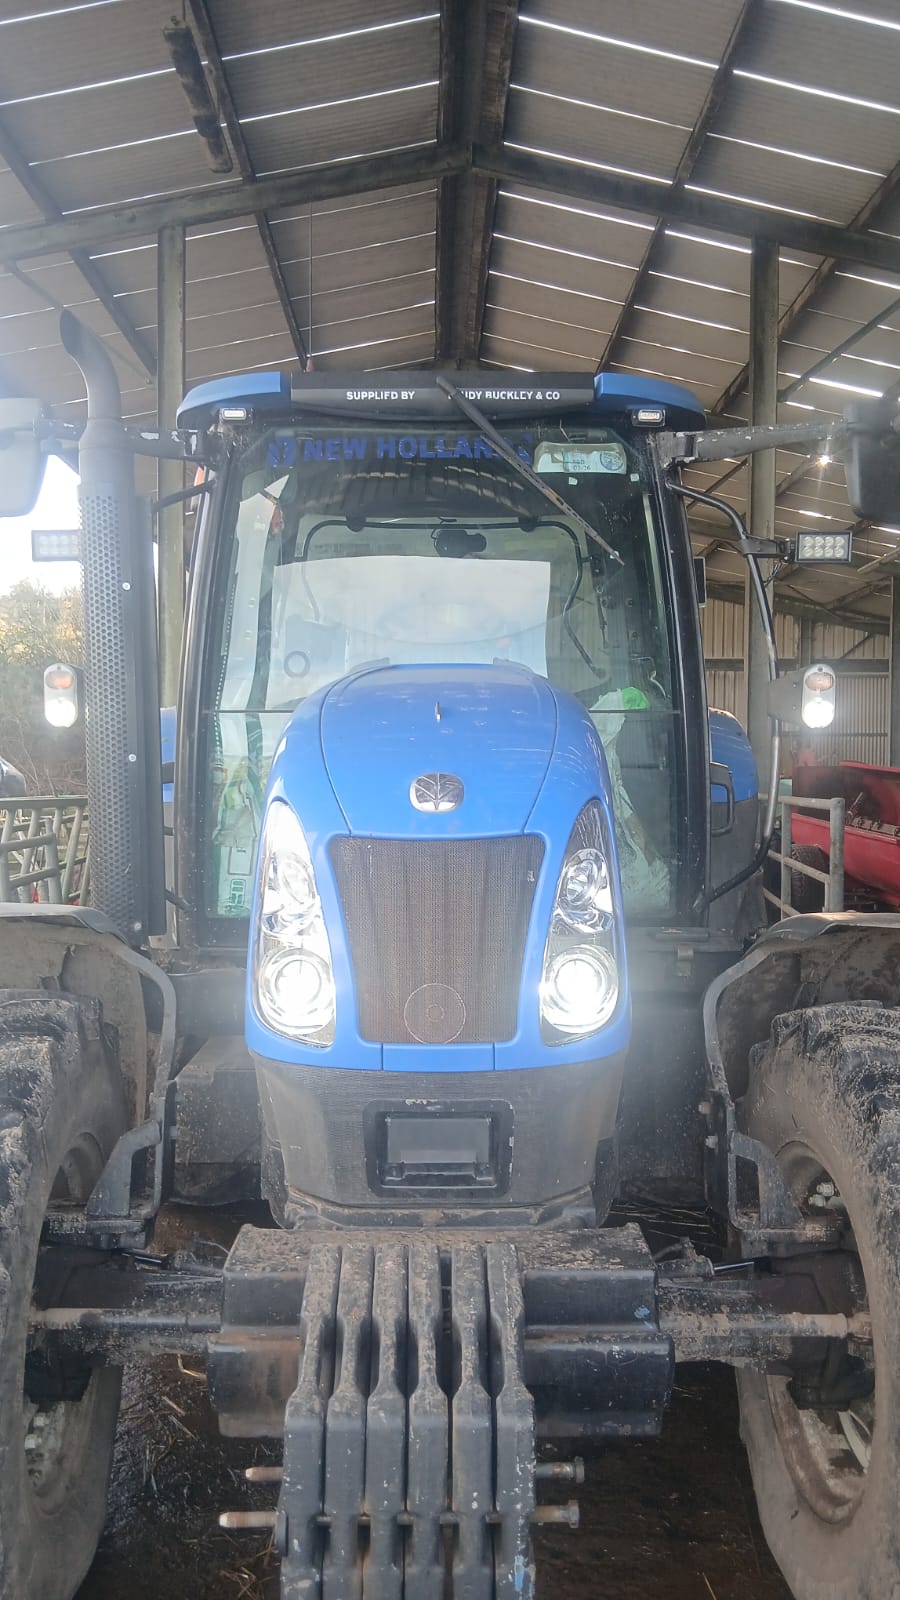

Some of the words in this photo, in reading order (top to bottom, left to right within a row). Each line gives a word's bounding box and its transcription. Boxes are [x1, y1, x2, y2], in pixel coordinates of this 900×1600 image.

[346, 391, 398, 400] SUPPLIED
[401, 391, 415, 400] BY
[485, 391, 533, 400] BUCKLEY
[535, 391, 543, 400] &
[545, 391, 561, 400] CO
[304, 436, 368, 461] NEW
[377, 435, 513, 460] HOLLAN
